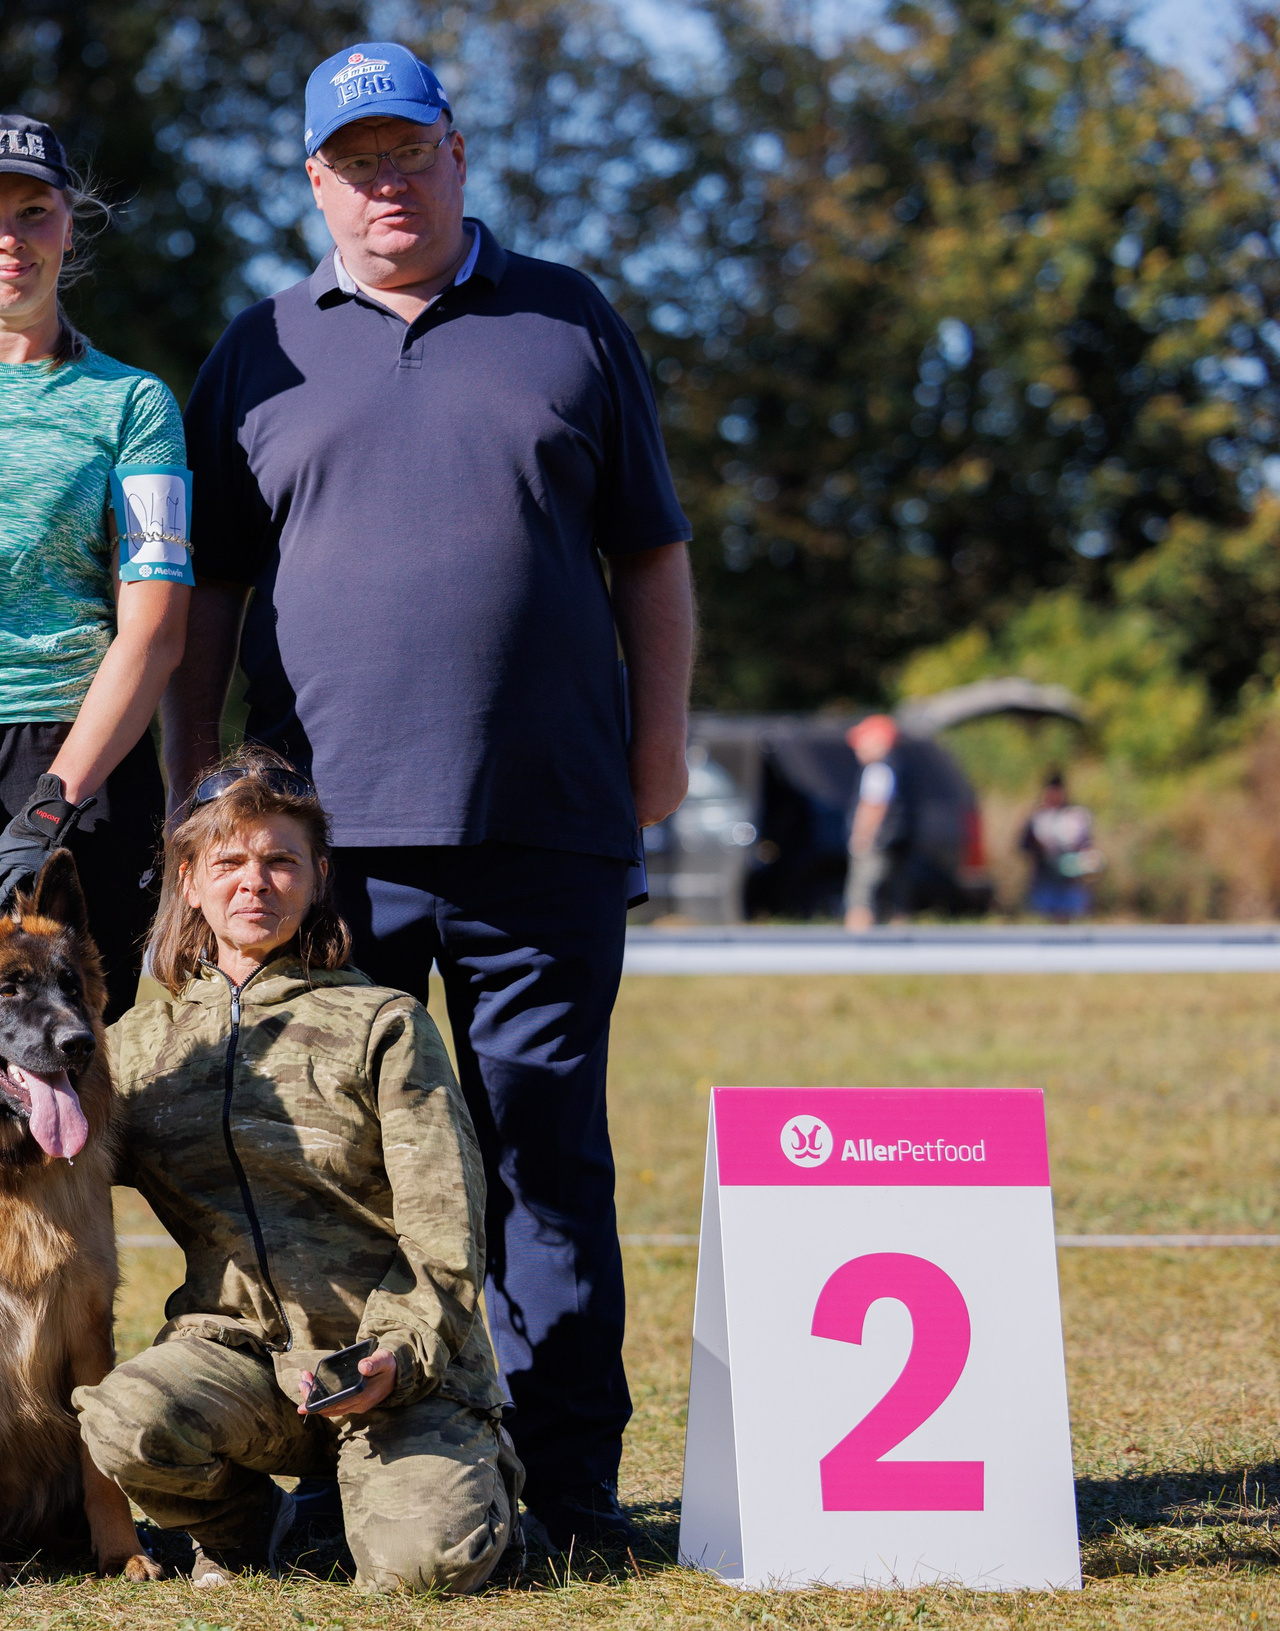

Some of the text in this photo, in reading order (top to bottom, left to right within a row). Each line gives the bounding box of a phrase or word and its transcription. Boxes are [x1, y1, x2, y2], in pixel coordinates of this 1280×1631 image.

[335, 73, 396, 108] 1946
[840, 1139, 987, 1162] AllerPetfood
[811, 1252, 985, 1511] 2
